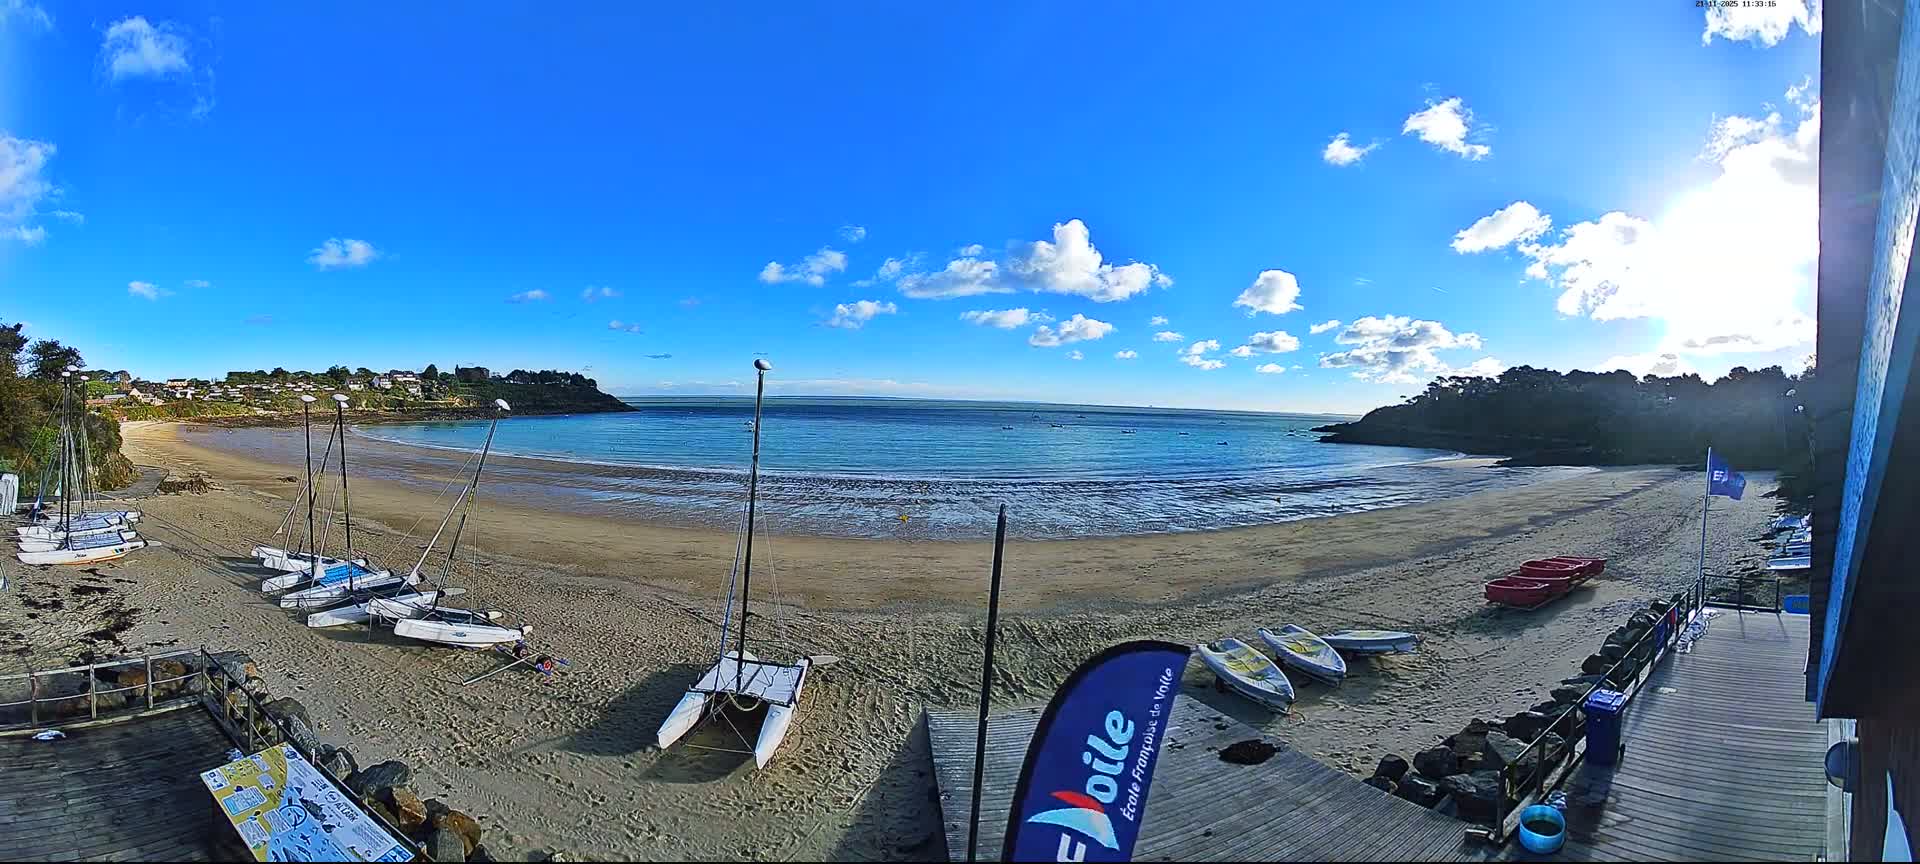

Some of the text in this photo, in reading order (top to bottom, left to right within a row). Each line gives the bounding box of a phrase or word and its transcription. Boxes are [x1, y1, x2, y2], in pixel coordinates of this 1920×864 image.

[1120, 667, 1173, 821] École Française de Voile
